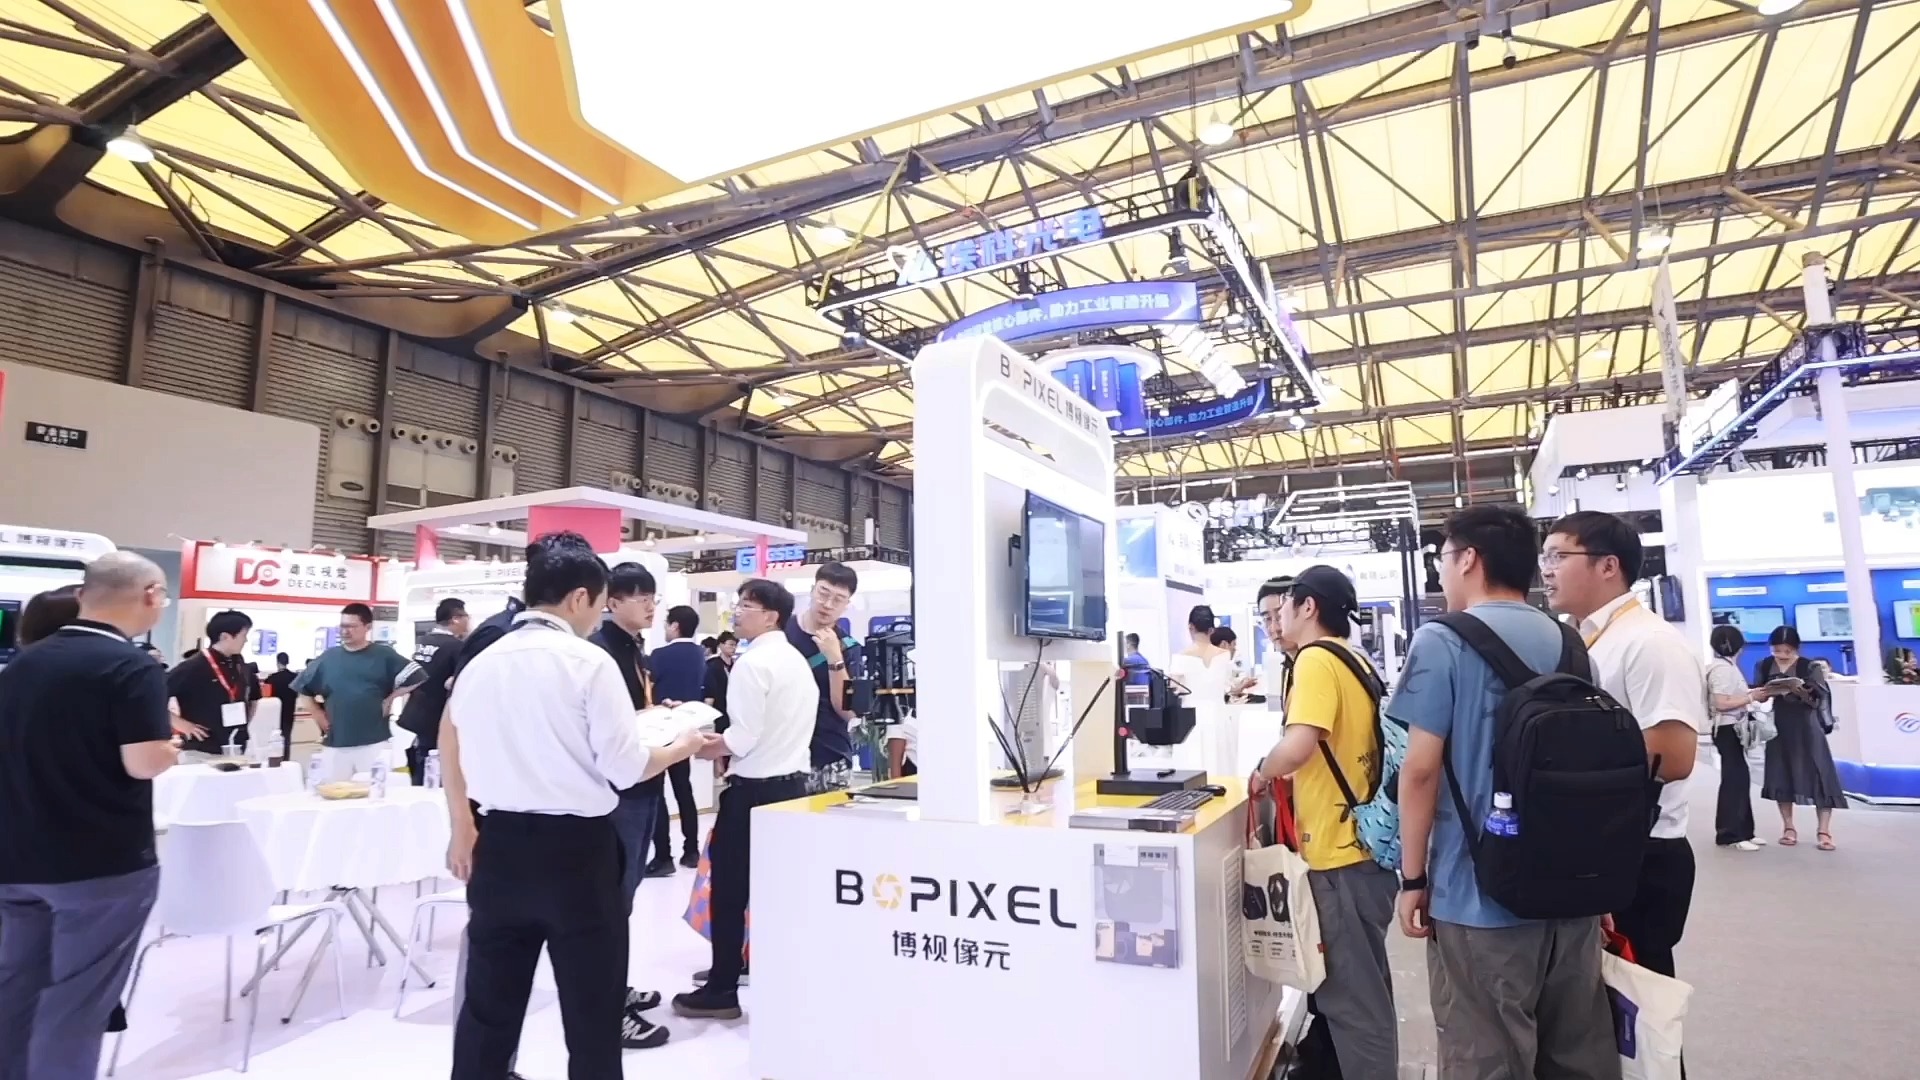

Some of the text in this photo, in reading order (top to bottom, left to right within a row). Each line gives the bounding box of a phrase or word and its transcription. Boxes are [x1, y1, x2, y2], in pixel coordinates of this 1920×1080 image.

[942, 206, 1103, 276] 埃科光电
[1000, 353, 1062, 415] BPIXEL
[287, 578, 347, 591] DECHENG
[835, 869, 1077, 929] BOPIXEL
[892, 930, 1010, 970] 博视像元
